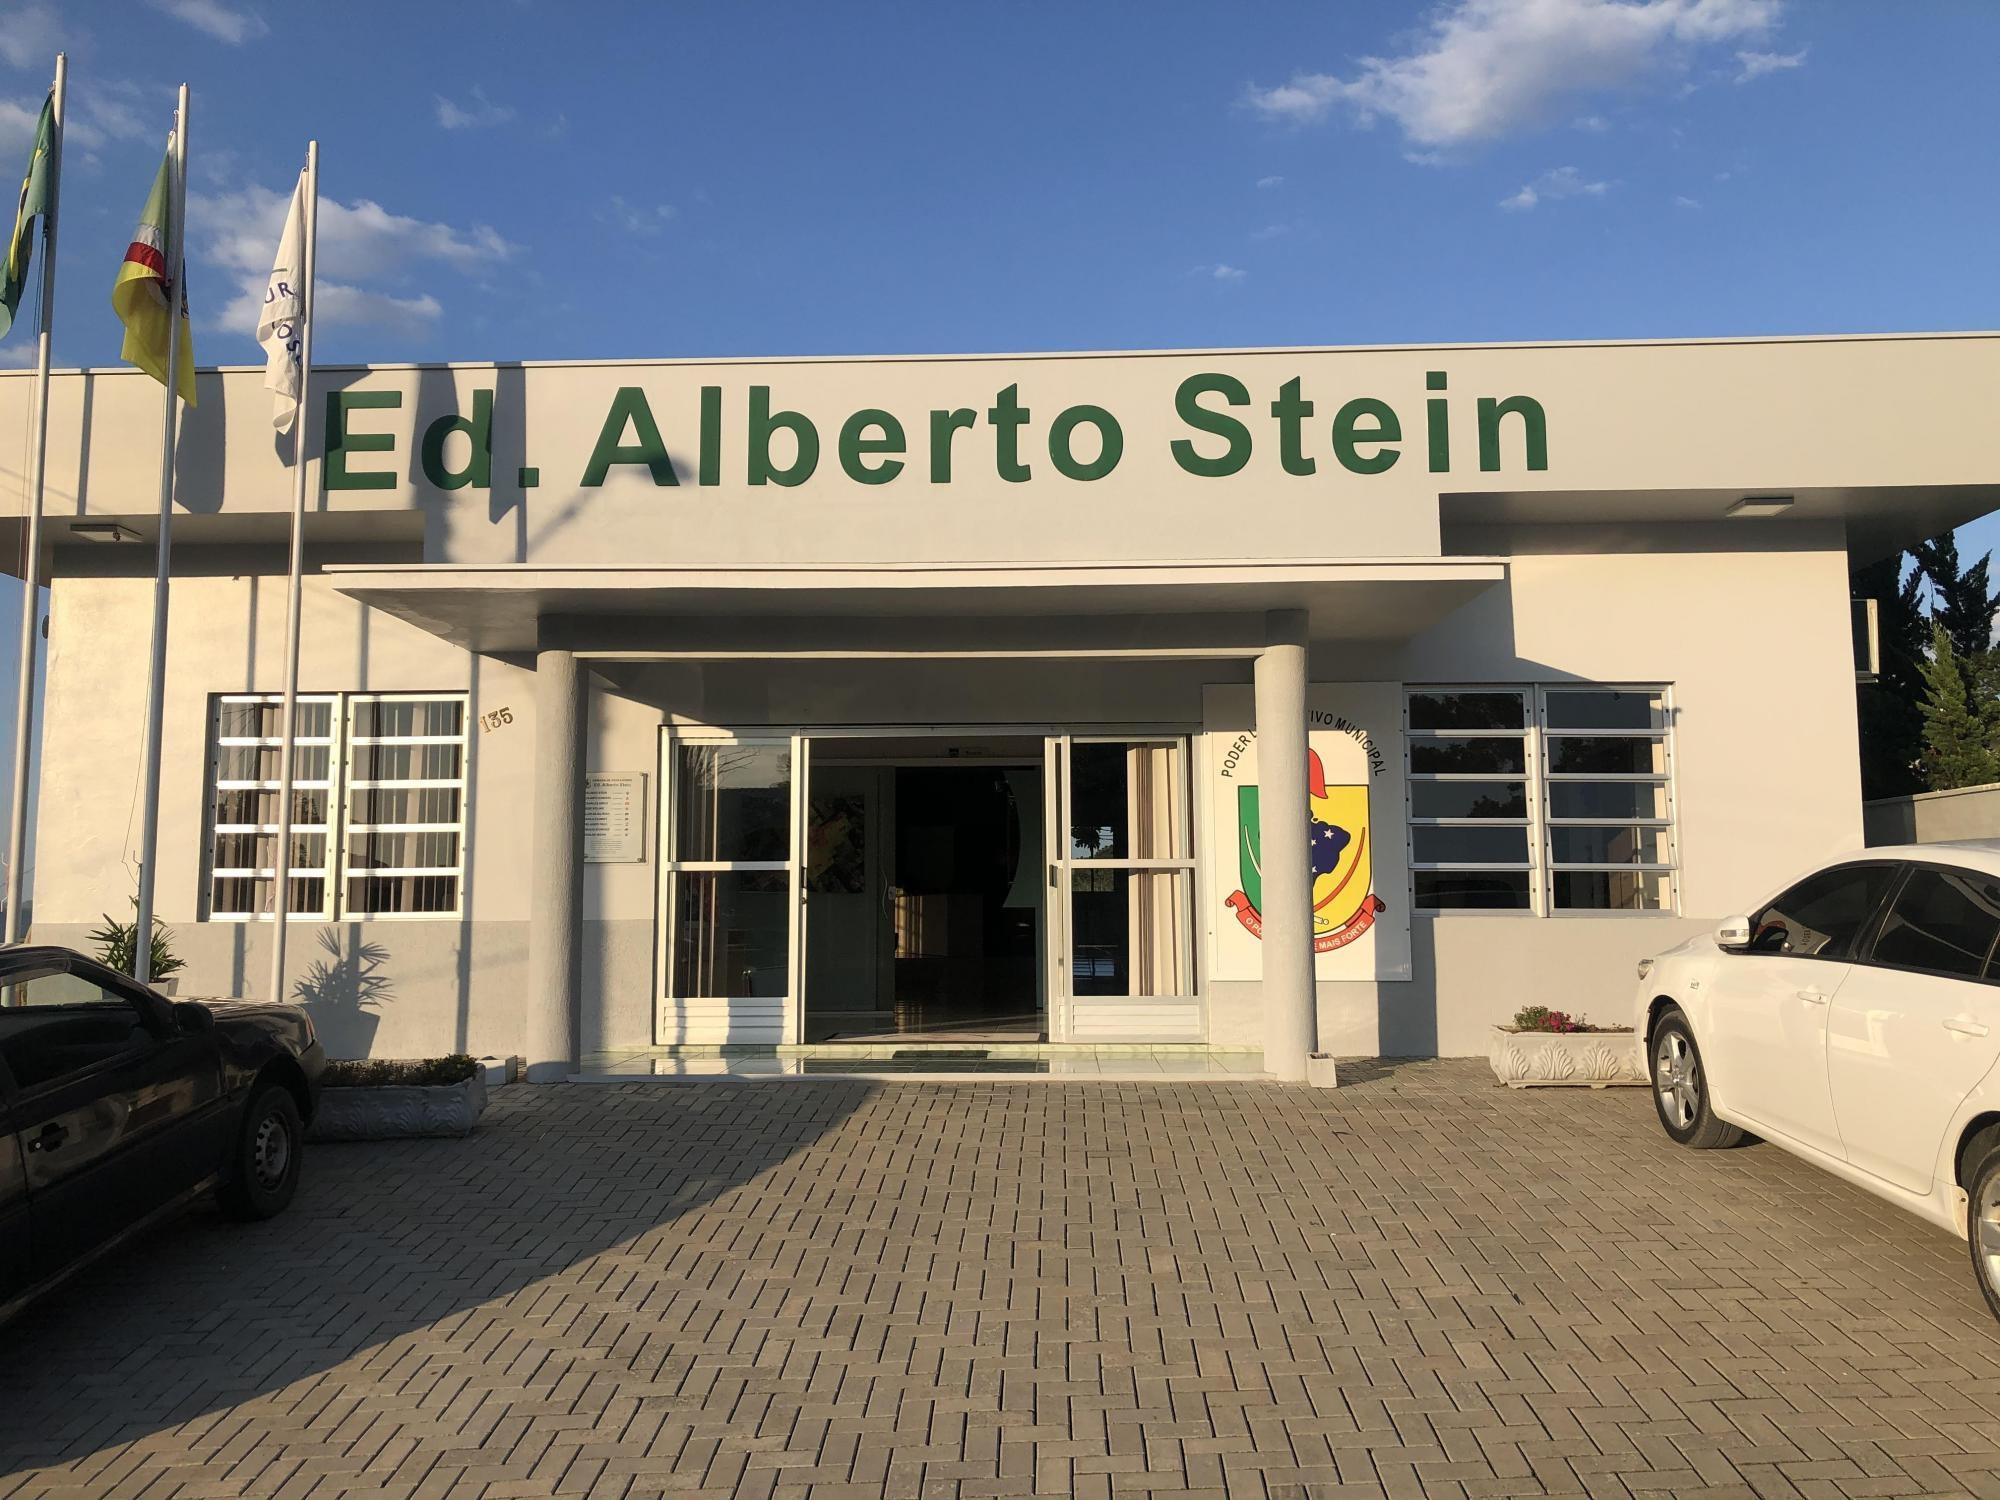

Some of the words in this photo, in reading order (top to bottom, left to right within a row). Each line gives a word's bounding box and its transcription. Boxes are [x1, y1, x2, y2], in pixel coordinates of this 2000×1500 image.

[323, 389, 539, 490] Ed.
[580, 385, 1124, 488] Alberto
[1170, 371, 1549, 477] Stein
[482, 706, 514, 733] 135
[1221, 734, 1252, 778] PODER
[1334, 717, 1387, 777] MUNICIPAL
[1318, 937, 1341, 950] MAIS
[1340, 920, 1367, 943] FORTE
